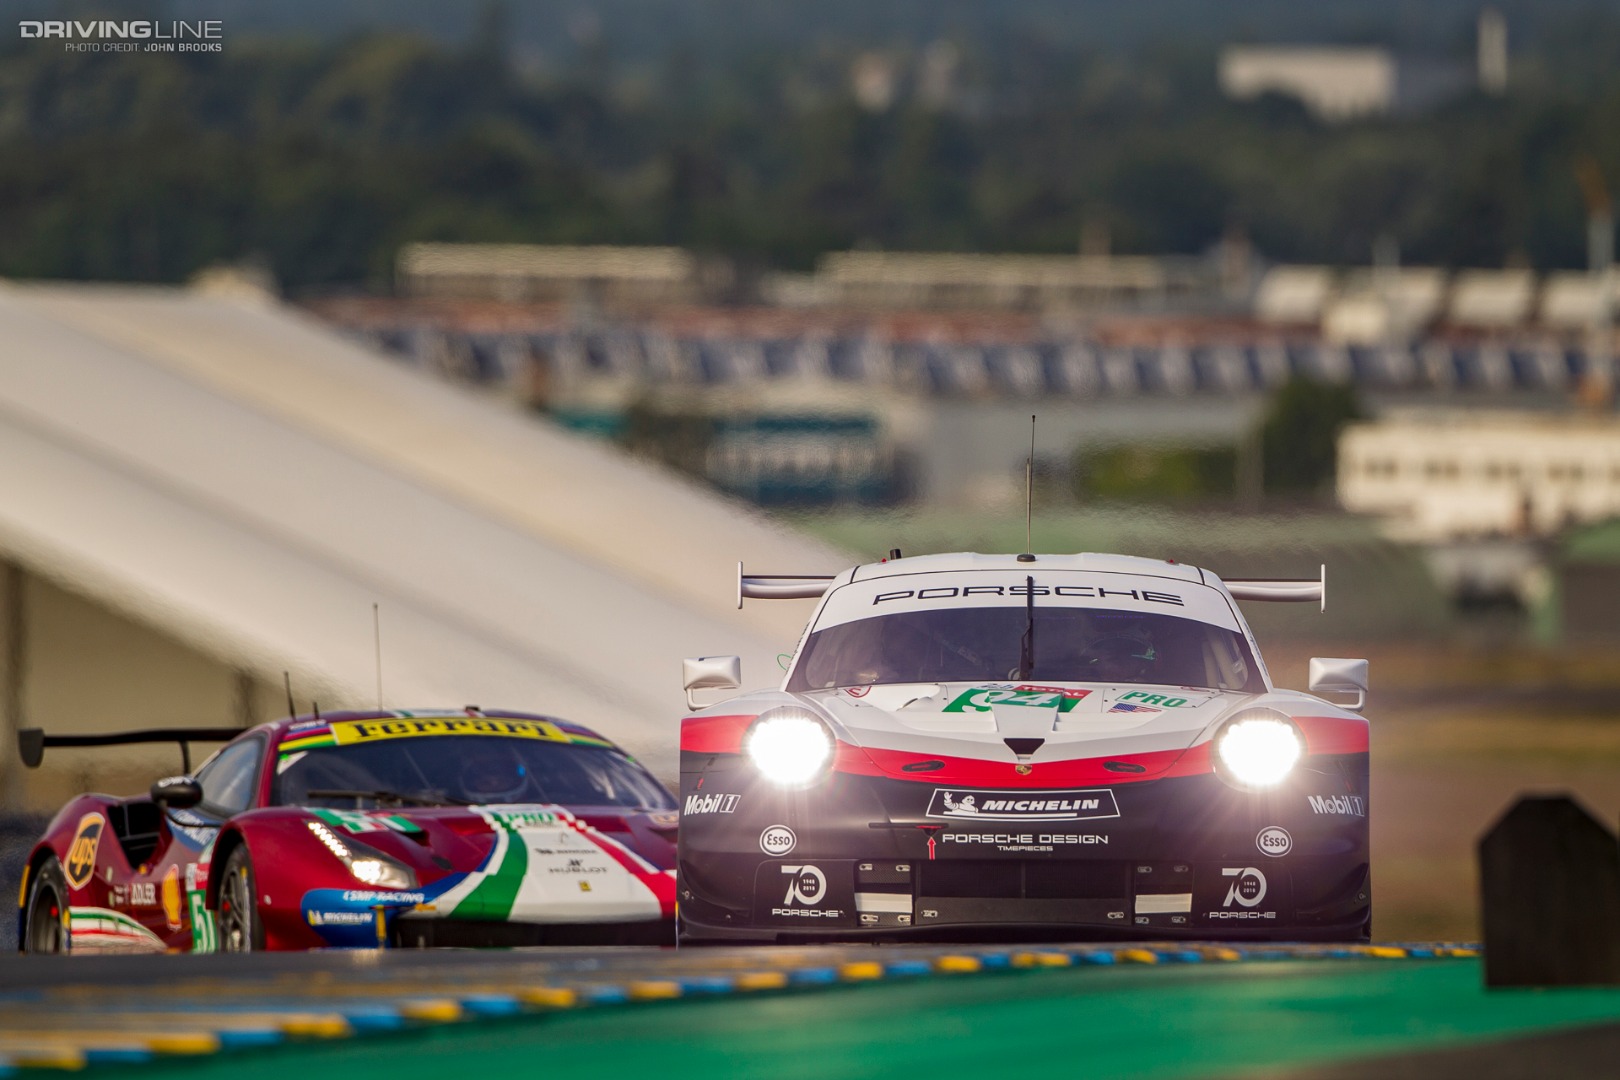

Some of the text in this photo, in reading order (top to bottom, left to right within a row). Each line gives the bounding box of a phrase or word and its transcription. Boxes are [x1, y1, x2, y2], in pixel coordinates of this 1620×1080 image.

[872, 585, 1185, 607] PORSCHE
[1021, 684, 1085, 698] TOTAL
[1123, 691, 1188, 708] PRO
[352, 722, 550, 738] Ferrari
[684, 794, 724, 816] Mobil
[982, 799, 1099, 811] MICHELIN
[1308, 795, 1353, 814] Mobil
[767, 833, 790, 846] Esso
[942, 834, 1109, 844] PORSCHE DESIGN
[1263, 835, 1287, 847] Esso
[781, 865, 827, 906] 70
[1222, 867, 1267, 907] 70
[771, 908, 839, 918] PORSCHE
[1209, 911, 1276, 919] PORSCHE
